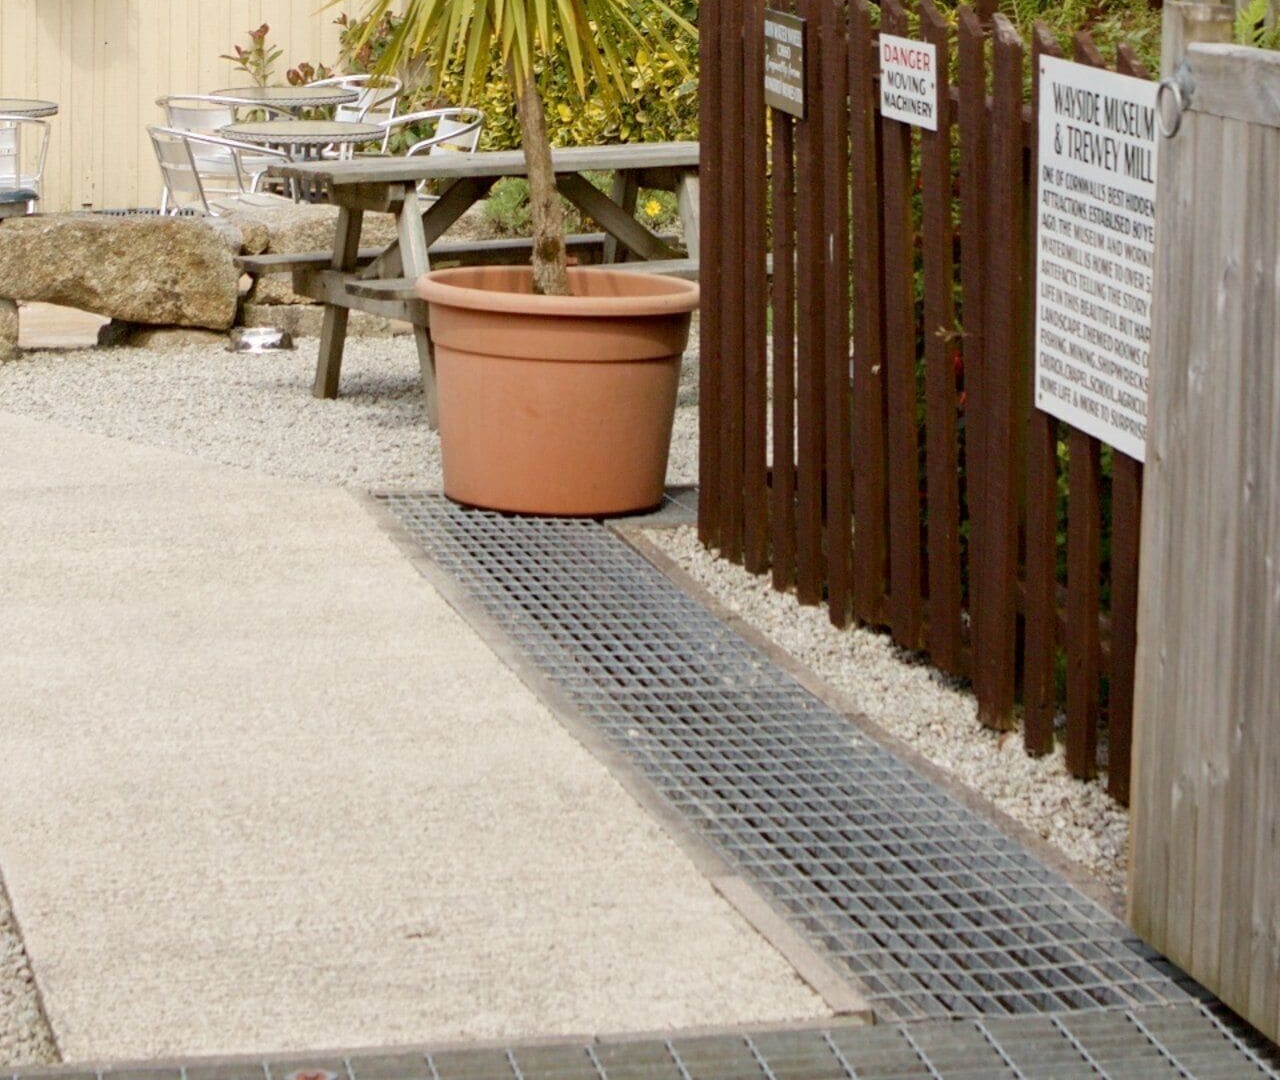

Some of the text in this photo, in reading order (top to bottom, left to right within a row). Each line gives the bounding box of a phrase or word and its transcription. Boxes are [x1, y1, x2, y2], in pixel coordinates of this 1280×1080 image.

[883, 44, 931, 71] DANGER
[883, 90, 933, 118] MACHINERY
[887, 71, 926, 96] MOVING
[1053, 82, 1154, 142] WAYSIDE MUSEUM
[1054, 122, 1154, 183] & TREWEY MILL
[1042, 165, 1053, 183] ONE
[1055, 169, 1063, 187] OF
[1107, 186, 1124, 207] BEST
[1125, 192, 1154, 217] HIDDEN
[1058, 218, 1071, 237] THE
[1073, 224, 1104, 250] MUSEUM
[1107, 236, 1122, 256] AND
[1092, 254, 1112, 277] HOME
[1114, 262, 1122, 281] TO
[1124, 266, 1144, 289] OVER
[1041, 282, 1054, 302] LIFE
[1056, 288, 1062, 306] IN
[1064, 291, 1078, 313] THIS
[1080, 298, 1117, 329] BEAUTIFUL
[1119, 314, 1132, 335] BUT
[1079, 274, 1106, 299] TELLING
[1107, 285, 1120, 305] THE
[1122, 291, 1146, 316] STORY
[1083, 323, 1113, 352] THEMED
[1114, 336, 1140, 364] ROOMS
[1039, 374, 1056, 396] HOME
[1058, 383, 1070, 403] LIFE
[1079, 394, 1099, 418] MORE
[1100, 404, 1109, 422] TO
